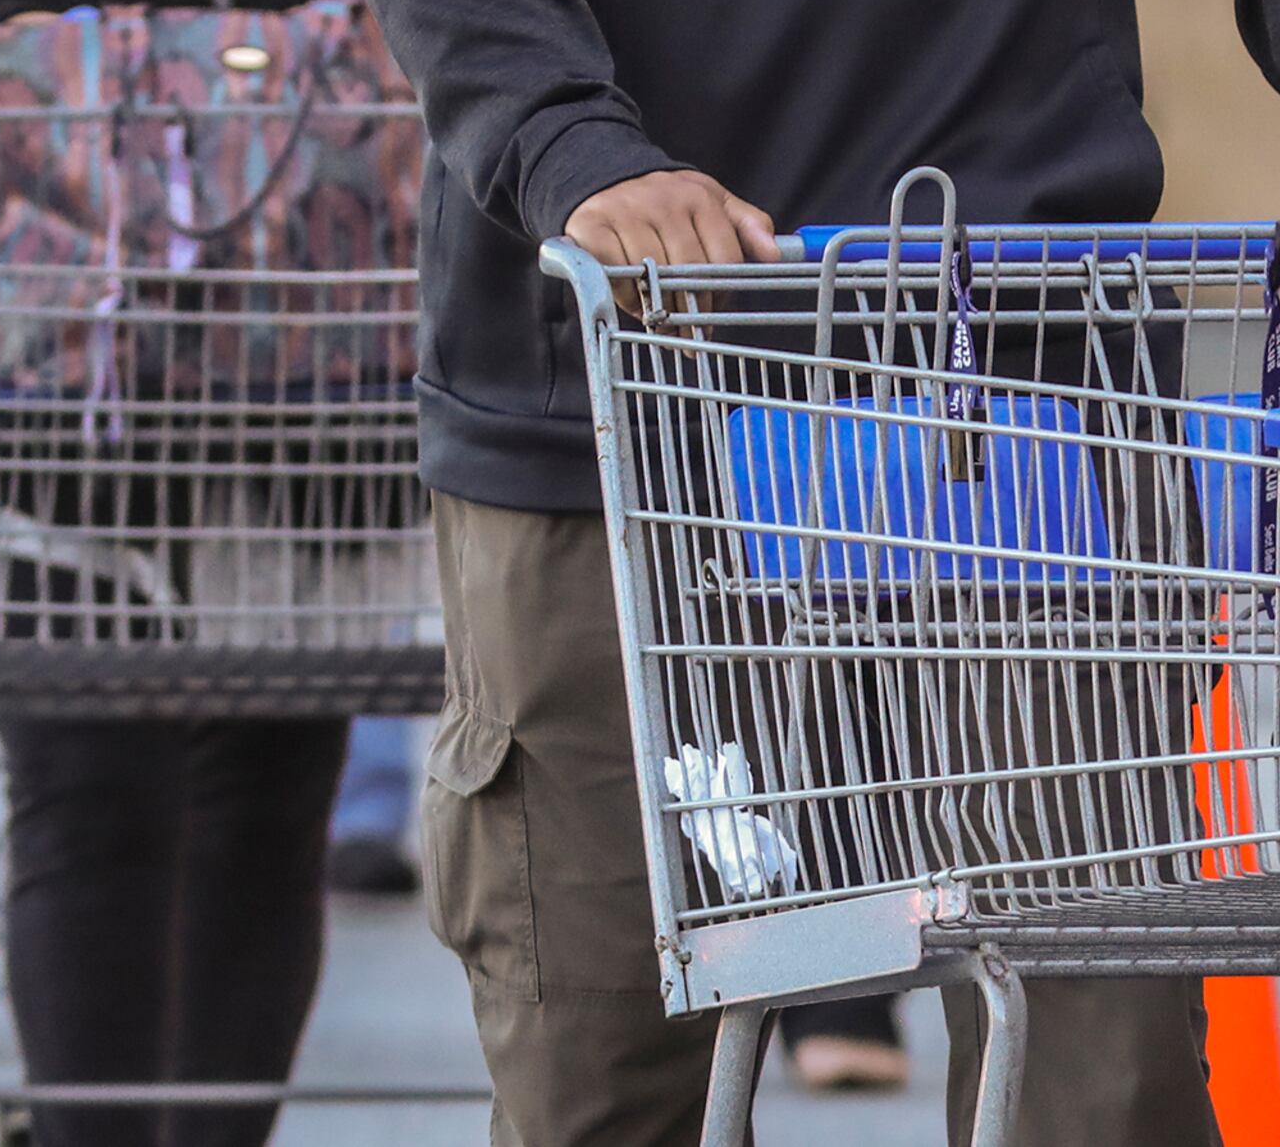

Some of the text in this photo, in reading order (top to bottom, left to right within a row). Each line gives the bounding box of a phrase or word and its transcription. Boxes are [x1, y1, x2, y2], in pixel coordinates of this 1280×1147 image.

[962, 322, 971, 368] CLUB
[1266, 333, 1276, 373] CLUB
[950, 389, 961, 412] Use
[1265, 468, 1277, 502] CLUB
